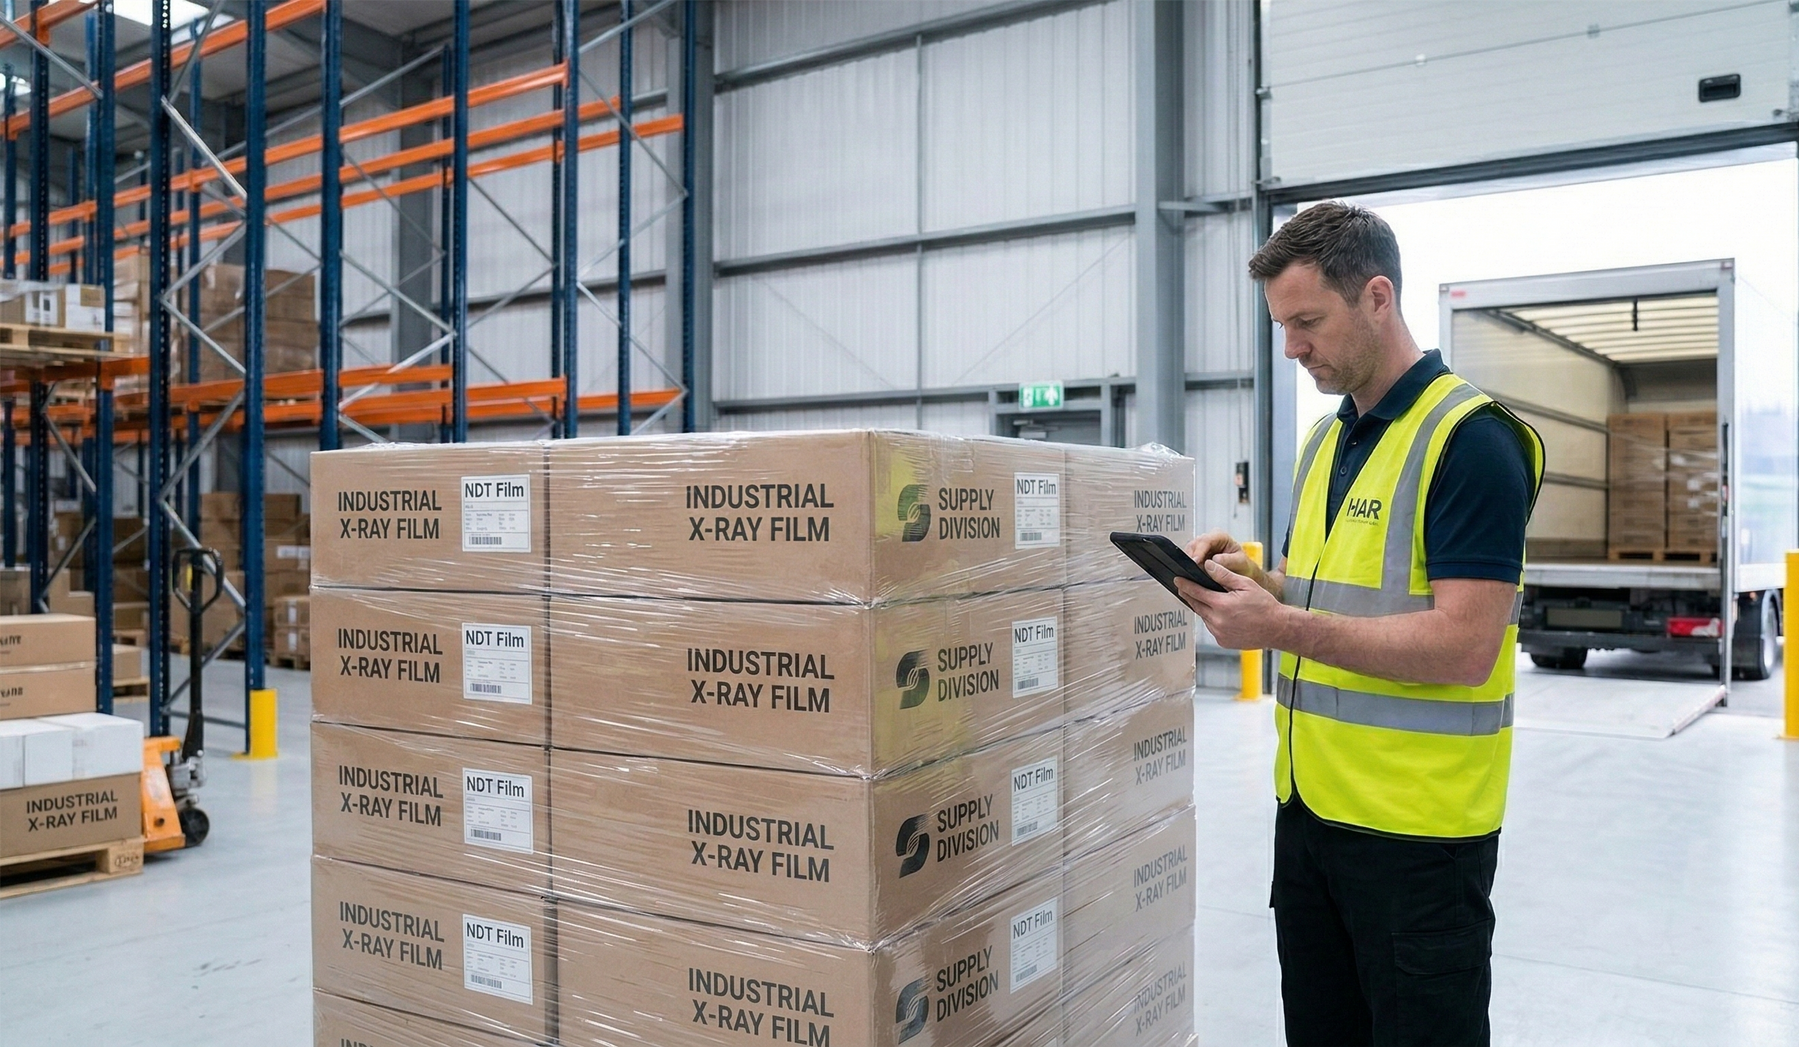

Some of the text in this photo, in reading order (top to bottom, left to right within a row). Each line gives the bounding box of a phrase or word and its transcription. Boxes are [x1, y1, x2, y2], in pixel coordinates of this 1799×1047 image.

[339, 490, 441, 511] INDUSTRIAL
[466, 482, 523, 497] NDT Film
[687, 484, 834, 508] INDUSTRIAL
[939, 488, 994, 510] SUPPLY
[1017, 479, 1056, 494] NDT Film
[1135, 490, 1186, 508] INDUSTRIAL
[341, 518, 439, 539] X-RAY FILM
[689, 517, 829, 541] X-RAY FILM
[940, 517, 999, 539] DIVISION
[1137, 515, 1184, 532] X-RAY FILM
[1015, 625, 1053, 643] NDT Film
[1135, 610, 1187, 635] INDUSTRIAL
[339, 629, 442, 655] INDUSTRIAL
[466, 630, 523, 647] NDT Film
[1136, 632, 1185, 659] X-RAY FILM
[341, 656, 392, 679] X-RAY
[398, 660, 439, 683] FILM
[688, 648, 834, 679] INDUSTRIAL
[938, 643, 994, 672] SUPPLY
[691, 680, 829, 712] X-RAY FILM
[939, 669, 998, 701] DIVISION
[1134, 726, 1187, 761] INDUSTRIAL
[1014, 767, 1053, 791] NDT Film
[1136, 749, 1185, 785] X-RAY FILM
[340, 765, 443, 798] INDUSTRIAL
[467, 776, 524, 797] NDT Film
[27, 788, 118, 814] INDUSTRIAL
[341, 792, 392, 820] X-RAY
[399, 800, 440, 826] FILM
[938, 795, 993, 832] SUPPLY
[29, 806, 118, 832] X-RAY FILM
[689, 810, 834, 850] INDUSTRIAL
[937, 821, 998, 862] DIVISION
[692, 841, 829, 882] X-RAY FILM
[1134, 844, 1188, 888] INDUSTRIAL
[1135, 866, 1187, 912] X-RAY FILM
[340, 902, 444, 943] INDUSTRIAL
[467, 923, 523, 948] NDT Film
[1014, 910, 1052, 939] NDT Film
[343, 929, 394, 958] X-RAY
[400, 941, 442, 970] FILM
[937, 945, 993, 992] SUPPLY
[689, 968, 834, 1018] INDUSTRIAL
[937, 969, 999, 1022] DIVISION
[693, 999, 830, 1047] X-RAY FILM
